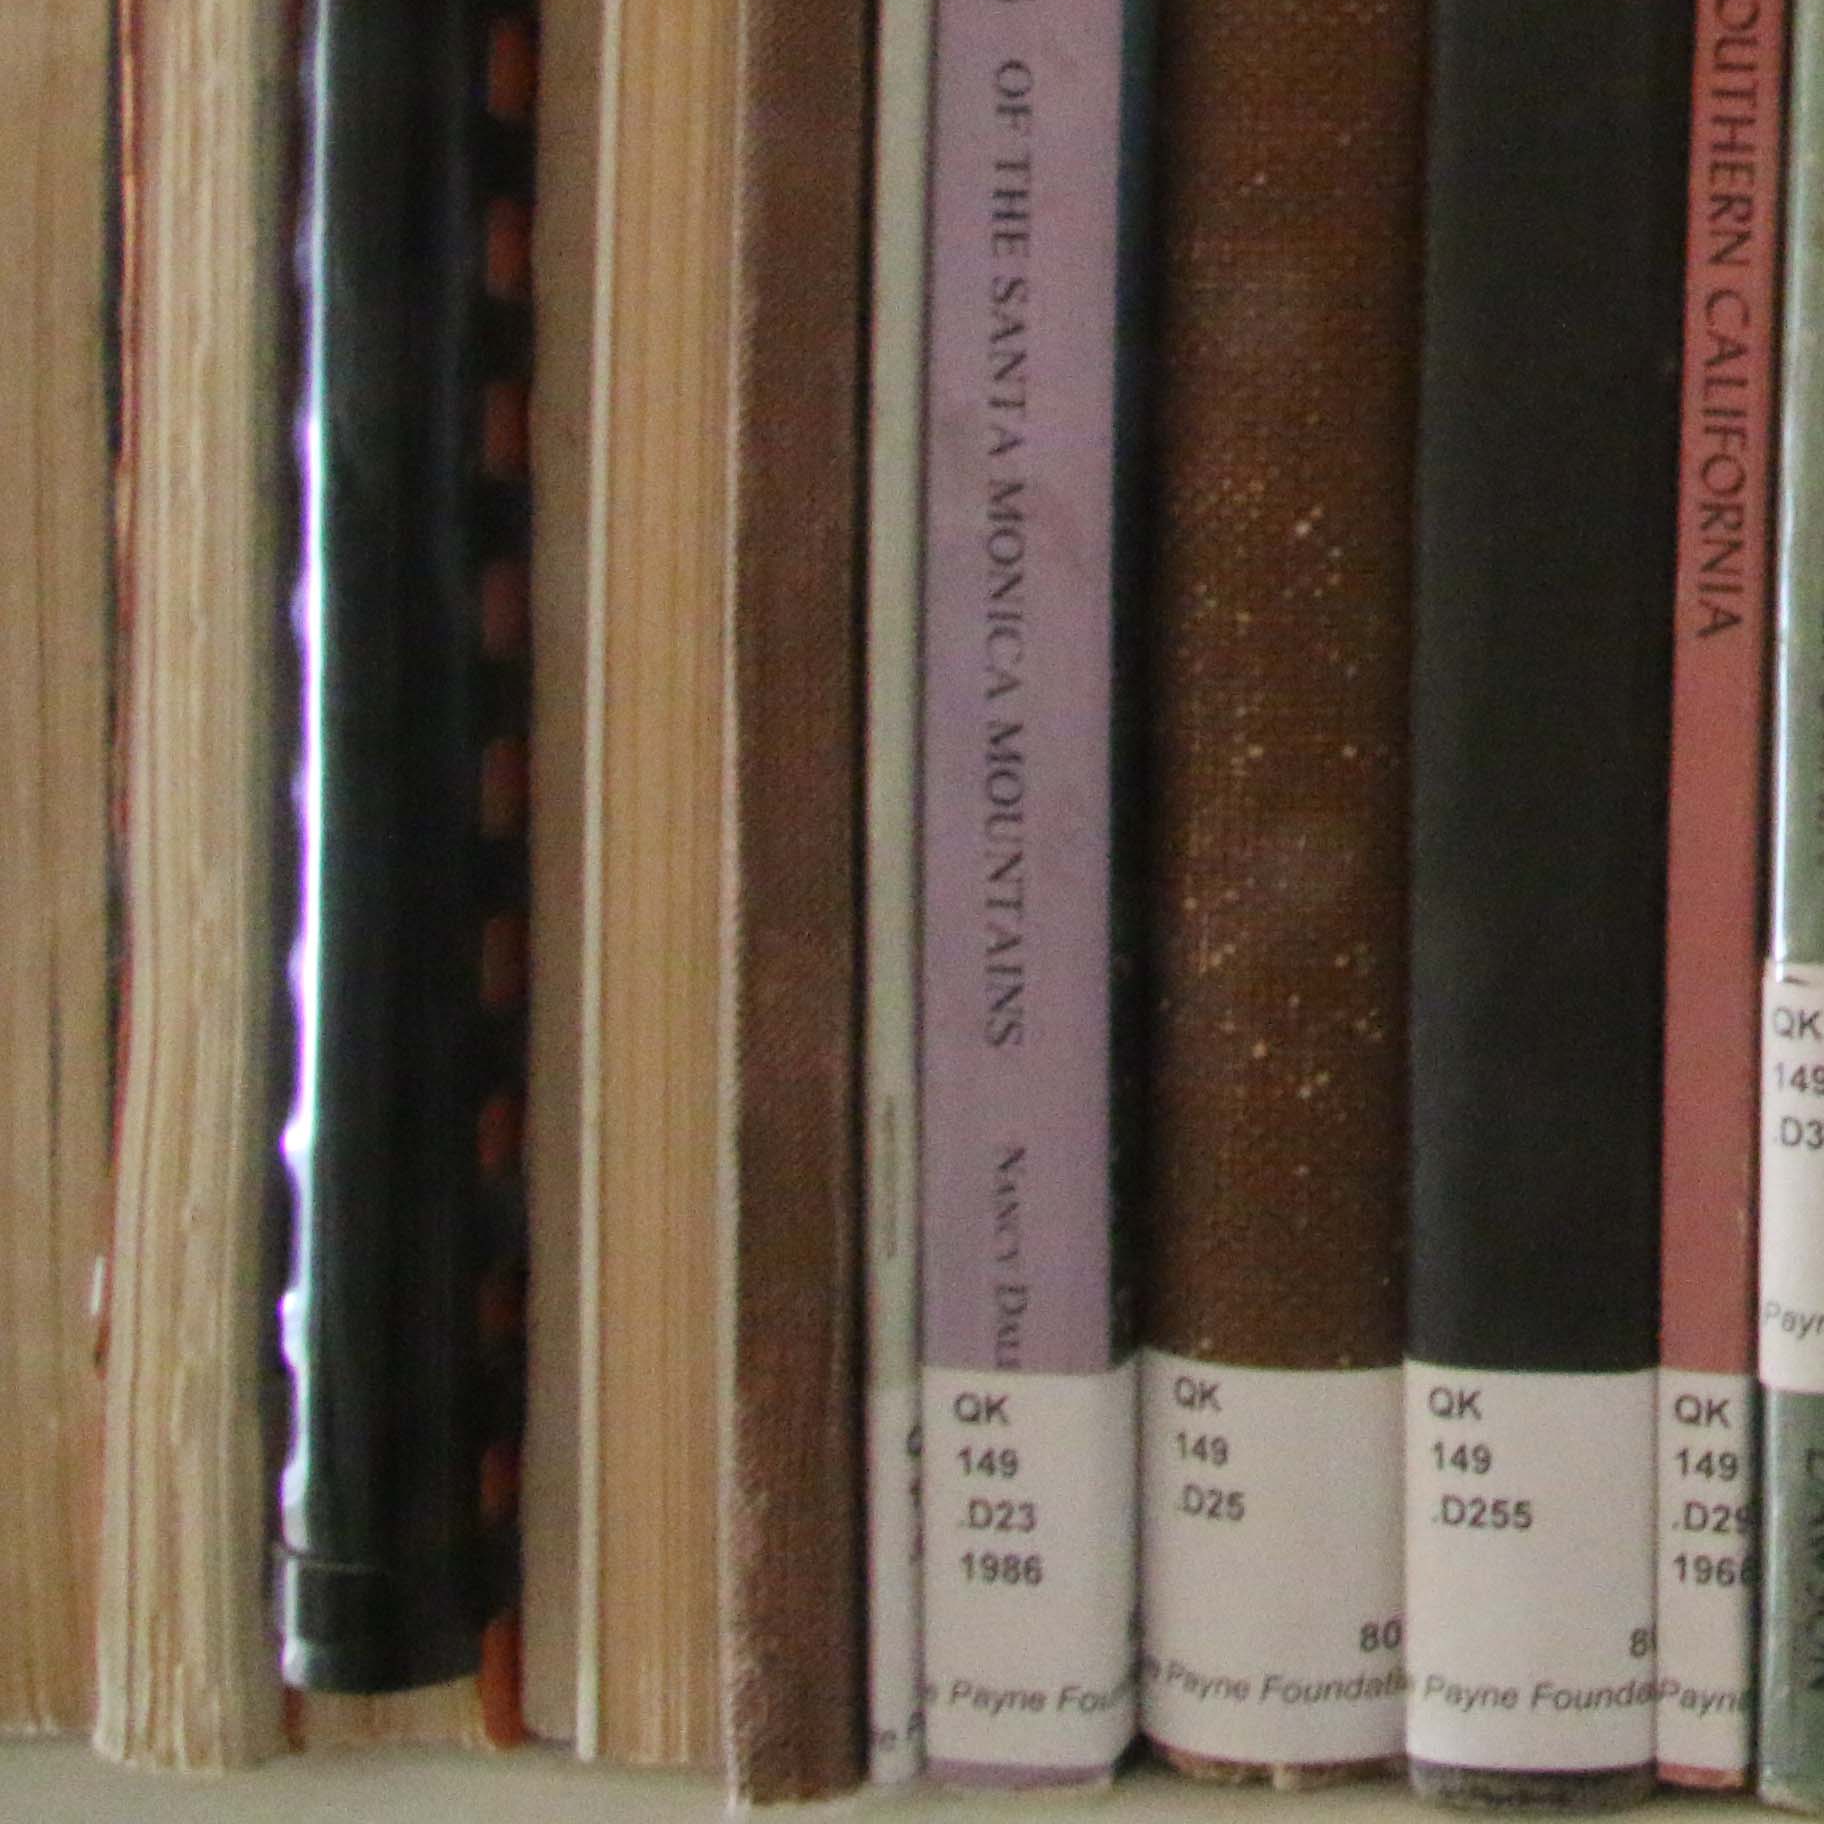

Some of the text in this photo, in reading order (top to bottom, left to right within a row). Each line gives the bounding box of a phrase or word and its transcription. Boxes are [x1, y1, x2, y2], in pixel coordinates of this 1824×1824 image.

[996, 59, 1034, 130] OF
[991, 159, 1031, 257] THE
[987, 276, 1028, 457] SANTA
[1696, 289, 1751, 640] CALIFORNIA
[984, 479, 1026, 700] MONICA
[984, 720, 1025, 1047] MOUNTAINS
[1773, 1007, 1823, 1042] QK
[954, 1393, 1010, 1424] QK
[1173, 1376, 1223, 1412] QK
[1429, 1386, 1484, 1421] QK
[1674, 1394, 1731, 1427] QK
[957, 1446, 1019, 1477] 149
[1177, 1432, 1229, 1467] 149
[1432, 1441, 1492, 1475] 149
[1674, 1448, 1739, 1482] 149
[960, 1498, 1039, 1533] .D23
[1178, 1484, 1246, 1522] .D25
[1432, 1495, 1534, 1530] .D255
[961, 1552, 1043, 1586] 1986
[952, 1679, 1046, 1717] Payne
[1424, 1675, 1518, 1712] Payne
